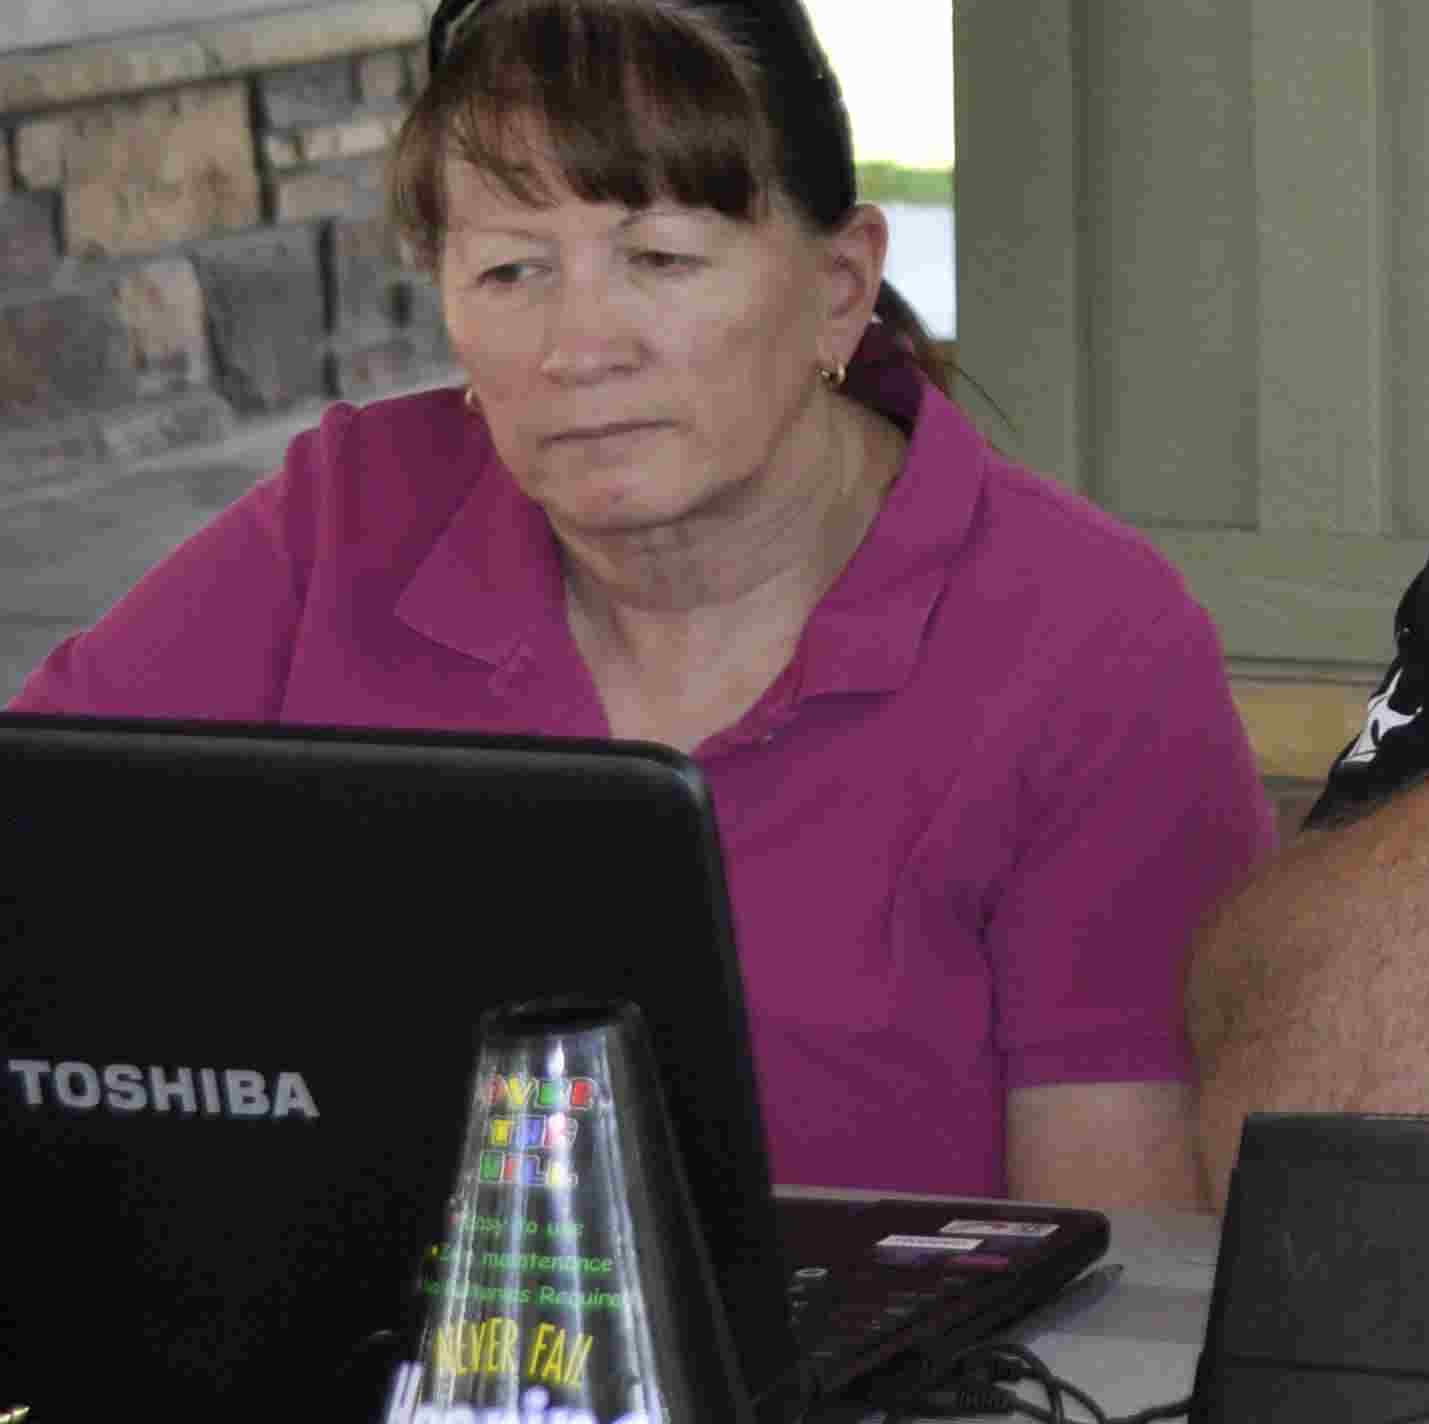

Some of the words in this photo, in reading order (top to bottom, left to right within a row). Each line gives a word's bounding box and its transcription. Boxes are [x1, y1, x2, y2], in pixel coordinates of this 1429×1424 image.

[8, 1058, 320, 1118] TOSHIBA
[480, 1250, 613, 1274] maintenance
[432, 1316, 518, 1377] NEVER
